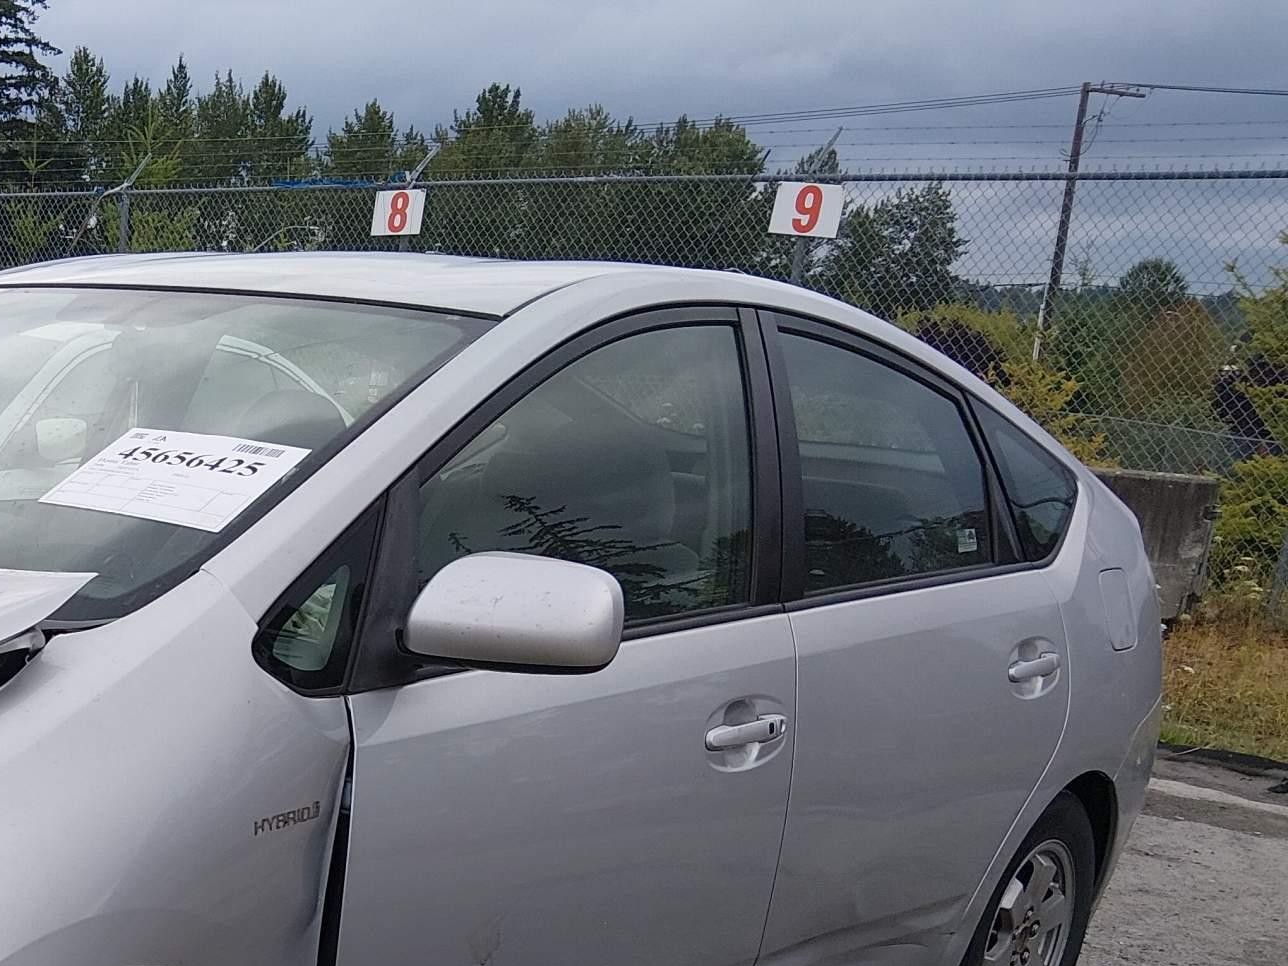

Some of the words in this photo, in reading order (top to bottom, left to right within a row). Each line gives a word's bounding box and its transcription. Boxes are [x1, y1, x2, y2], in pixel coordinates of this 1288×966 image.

[387, 191, 410, 233] 8
[791, 185, 824, 234] 9
[117, 445, 266, 478] 45656425
[253, 806, 312, 837] HYBRID
